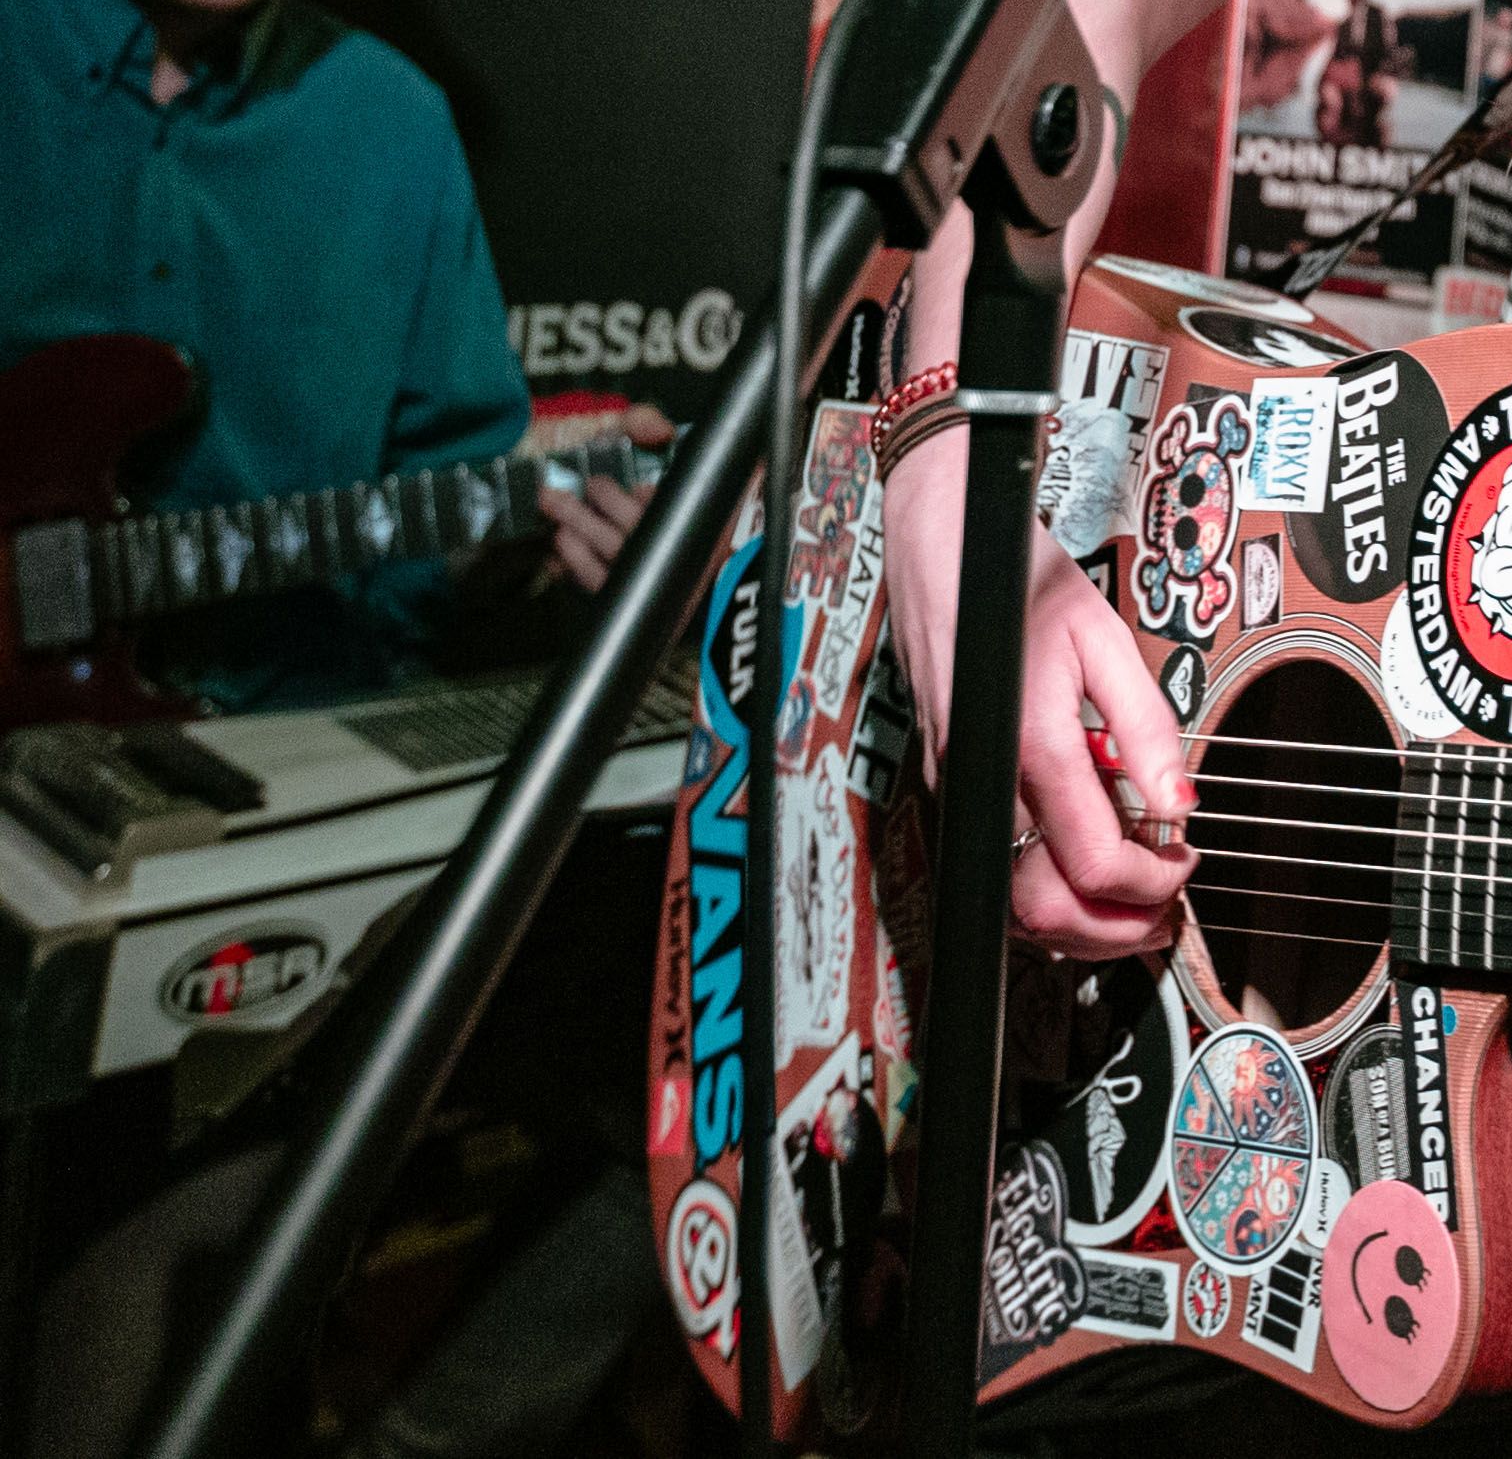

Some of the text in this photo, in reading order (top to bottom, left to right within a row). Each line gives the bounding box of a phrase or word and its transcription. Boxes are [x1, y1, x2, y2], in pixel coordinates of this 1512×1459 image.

[1270, 406, 1316, 494] ROXY
[1336, 360, 1399, 585] BEATLES
[1384, 436, 1408, 487] THE
[1410, 422, 1486, 717] AMSTERDAM
[1366, 1065, 1390, 1109] SON
[1316, 1171, 1332, 1218] Hurley
[1245, 1278, 1265, 1337] MNT
